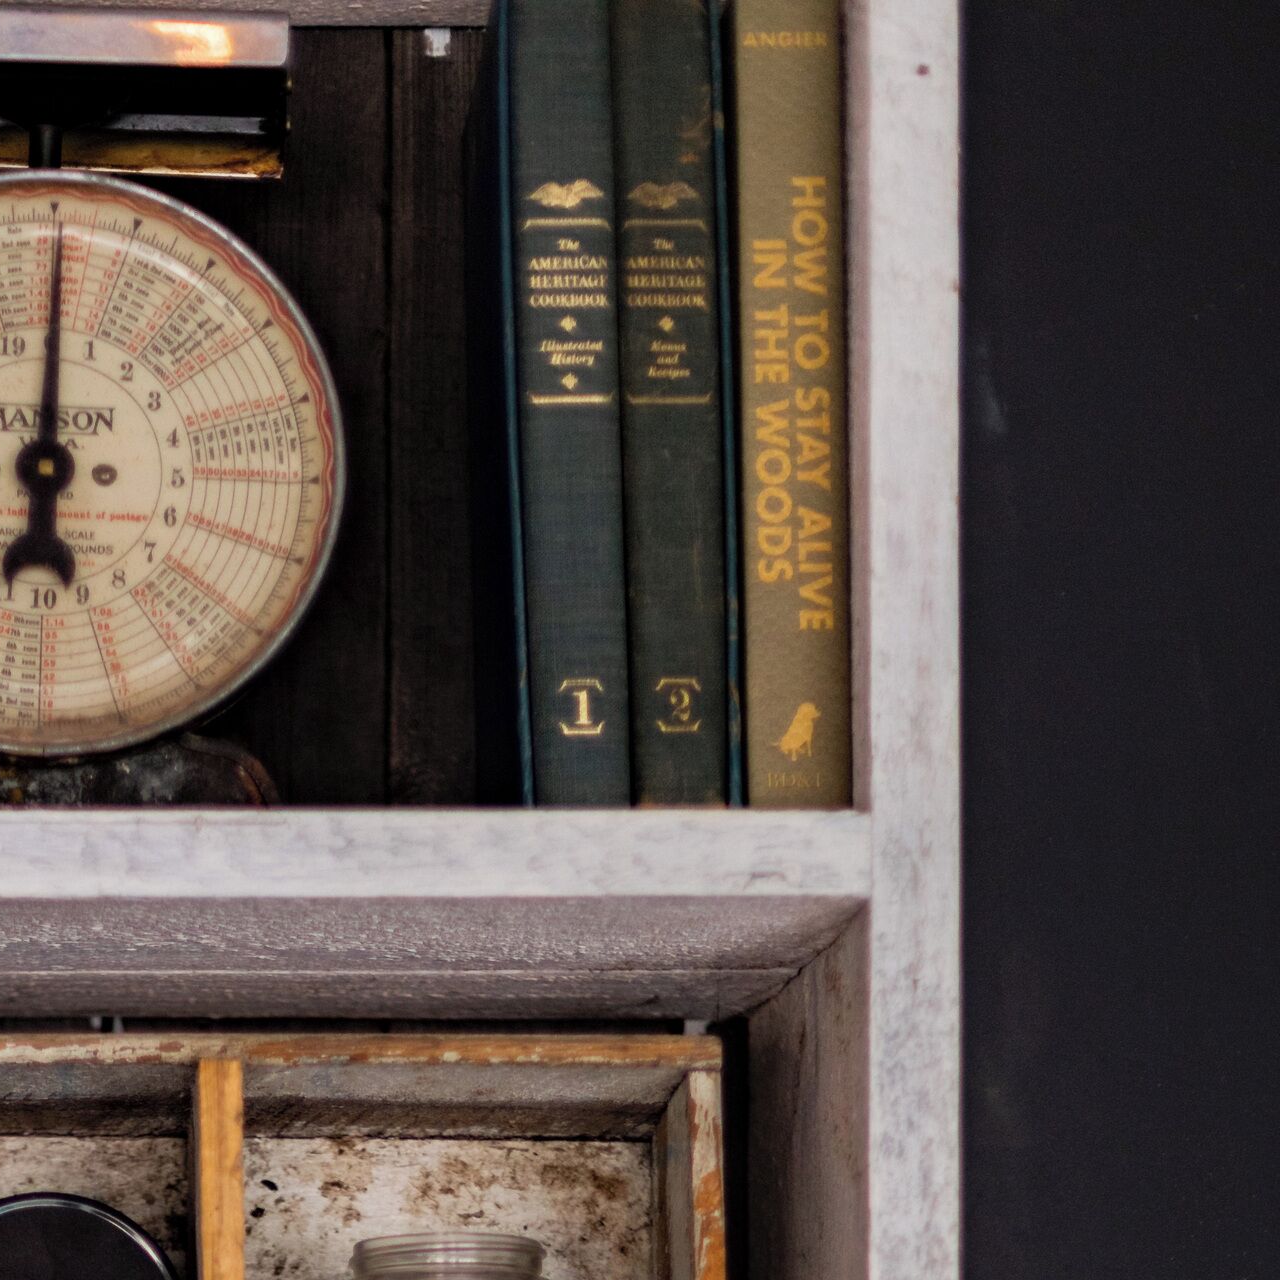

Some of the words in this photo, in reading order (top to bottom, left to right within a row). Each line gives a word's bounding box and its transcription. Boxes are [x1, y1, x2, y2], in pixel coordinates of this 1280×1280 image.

[743, 31, 828, 48] ANGIER
[557, 238, 580, 250] The
[653, 238, 674, 250] The
[791, 176, 829, 296] HOW
[528, 255, 607, 270] AMERICAN
[628, 256, 705, 269] AMERICAN
[752, 239, 788, 288] IN
[529, 275, 607, 288] HERITAGE
[628, 275, 706, 288] HERITAGE
[529, 294, 608, 308] COOKBOOK
[628, 294, 706, 308] COOKBOOK
[0, 336, 26, 357] 19
[540, 339, 603, 352] Illustrated
[650, 340, 687, 351] Menus
[754, 303, 790, 383] THE
[794, 309, 830, 370] TO
[83, 340, 95, 361] 1
[551, 353, 595, 367] History
[656, 353, 679, 364] and
[120, 362, 134, 382] 2
[648, 366, 691, 379] Recipes
[148, 391, 161, 412] 3
[166, 427, 179, 448] 4
[795, 387, 832, 492] STAY
[171, 468, 185, 488] 5
[755, 399, 793, 583] WOODS
[96, 511, 106, 519] of
[110, 512, 148, 524] postage
[164, 505, 176, 527] 6
[64, 530, 95, 540] SCALE
[144, 540, 156, 563] 7
[797, 506, 834, 630] ALIVE
[112, 568, 126, 589] 8
[30, 587, 57, 610] 10
[76, 584, 89, 605] 9
[572, 690, 592, 724] 1
[670, 688, 691, 721] 2
